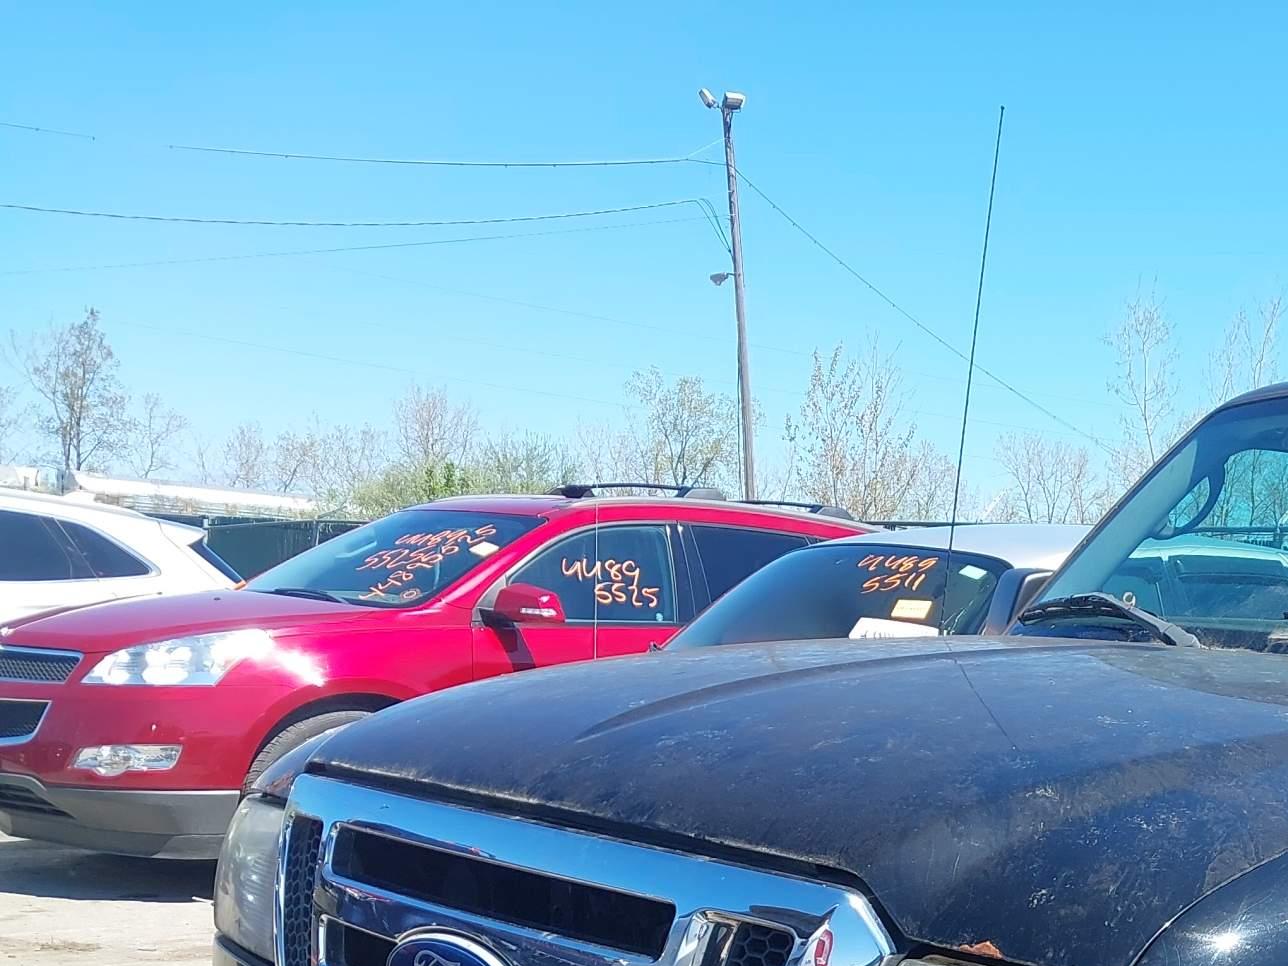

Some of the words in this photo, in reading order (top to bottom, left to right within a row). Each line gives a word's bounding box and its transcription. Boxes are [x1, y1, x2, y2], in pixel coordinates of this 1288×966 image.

[562, 558, 640, 586] 4489
[858, 554, 939, 571] 4489
[594, 582, 660, 607] 5525
[860, 573, 926, 594] 5511
